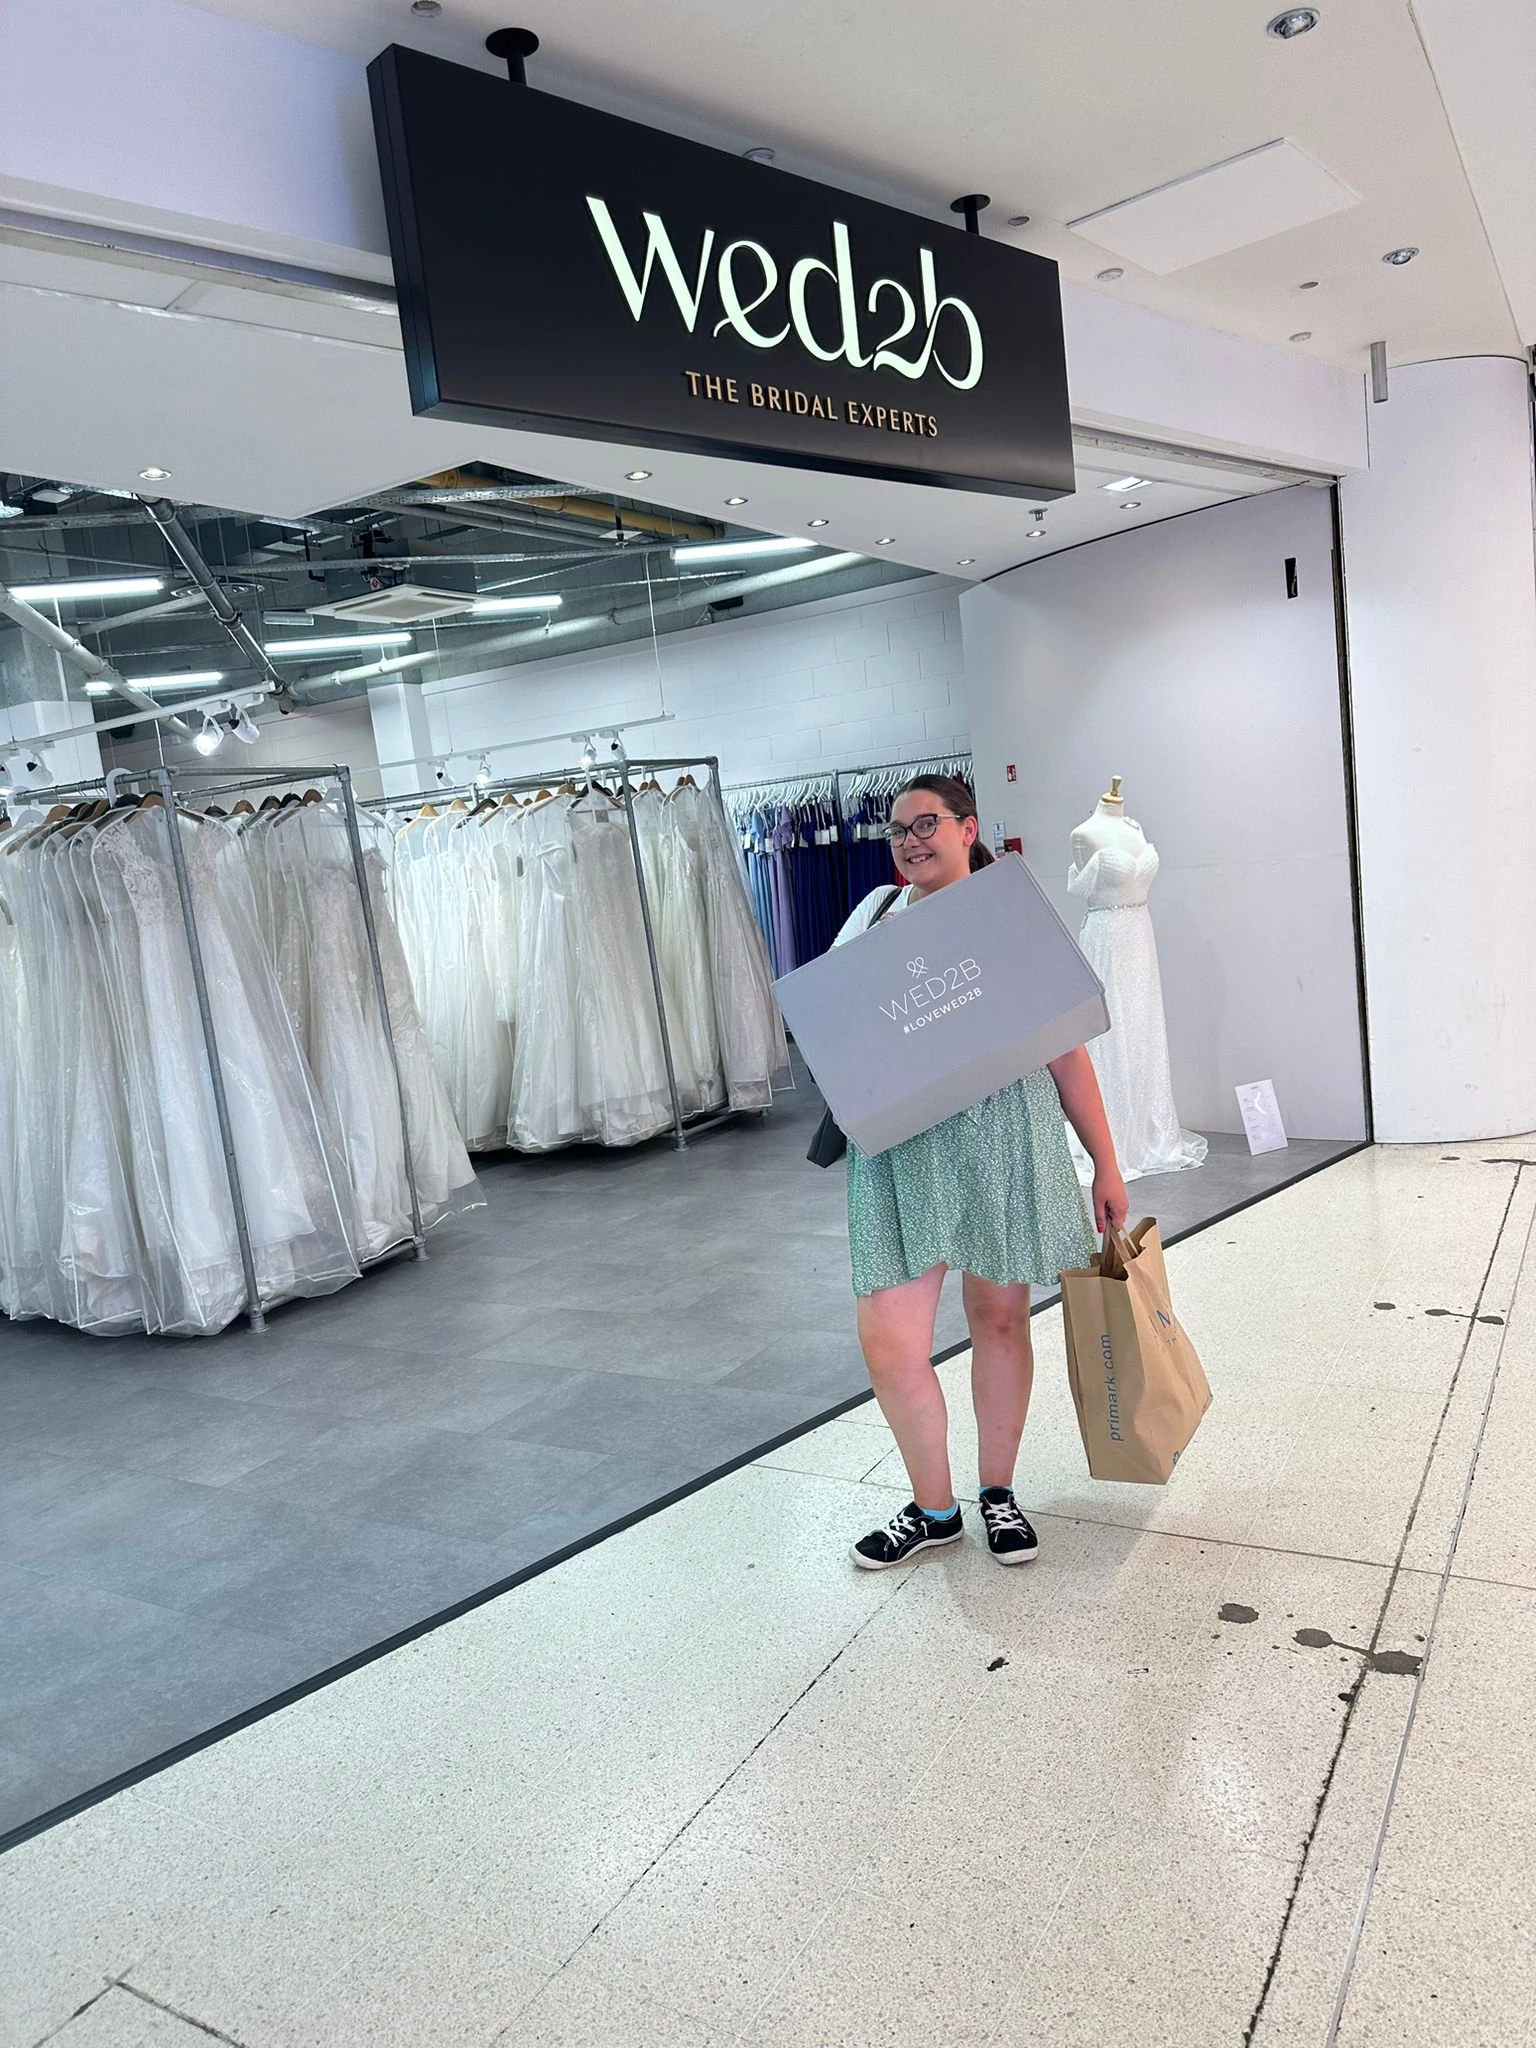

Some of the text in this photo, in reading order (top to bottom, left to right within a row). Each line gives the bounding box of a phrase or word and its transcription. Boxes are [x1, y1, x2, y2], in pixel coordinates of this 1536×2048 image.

[685, 370, 939, 437] THE BRIDAL EXPERTS
[878, 958, 981, 1021] WED2B
[903, 987, 983, 1034] #LOVEWED2B
